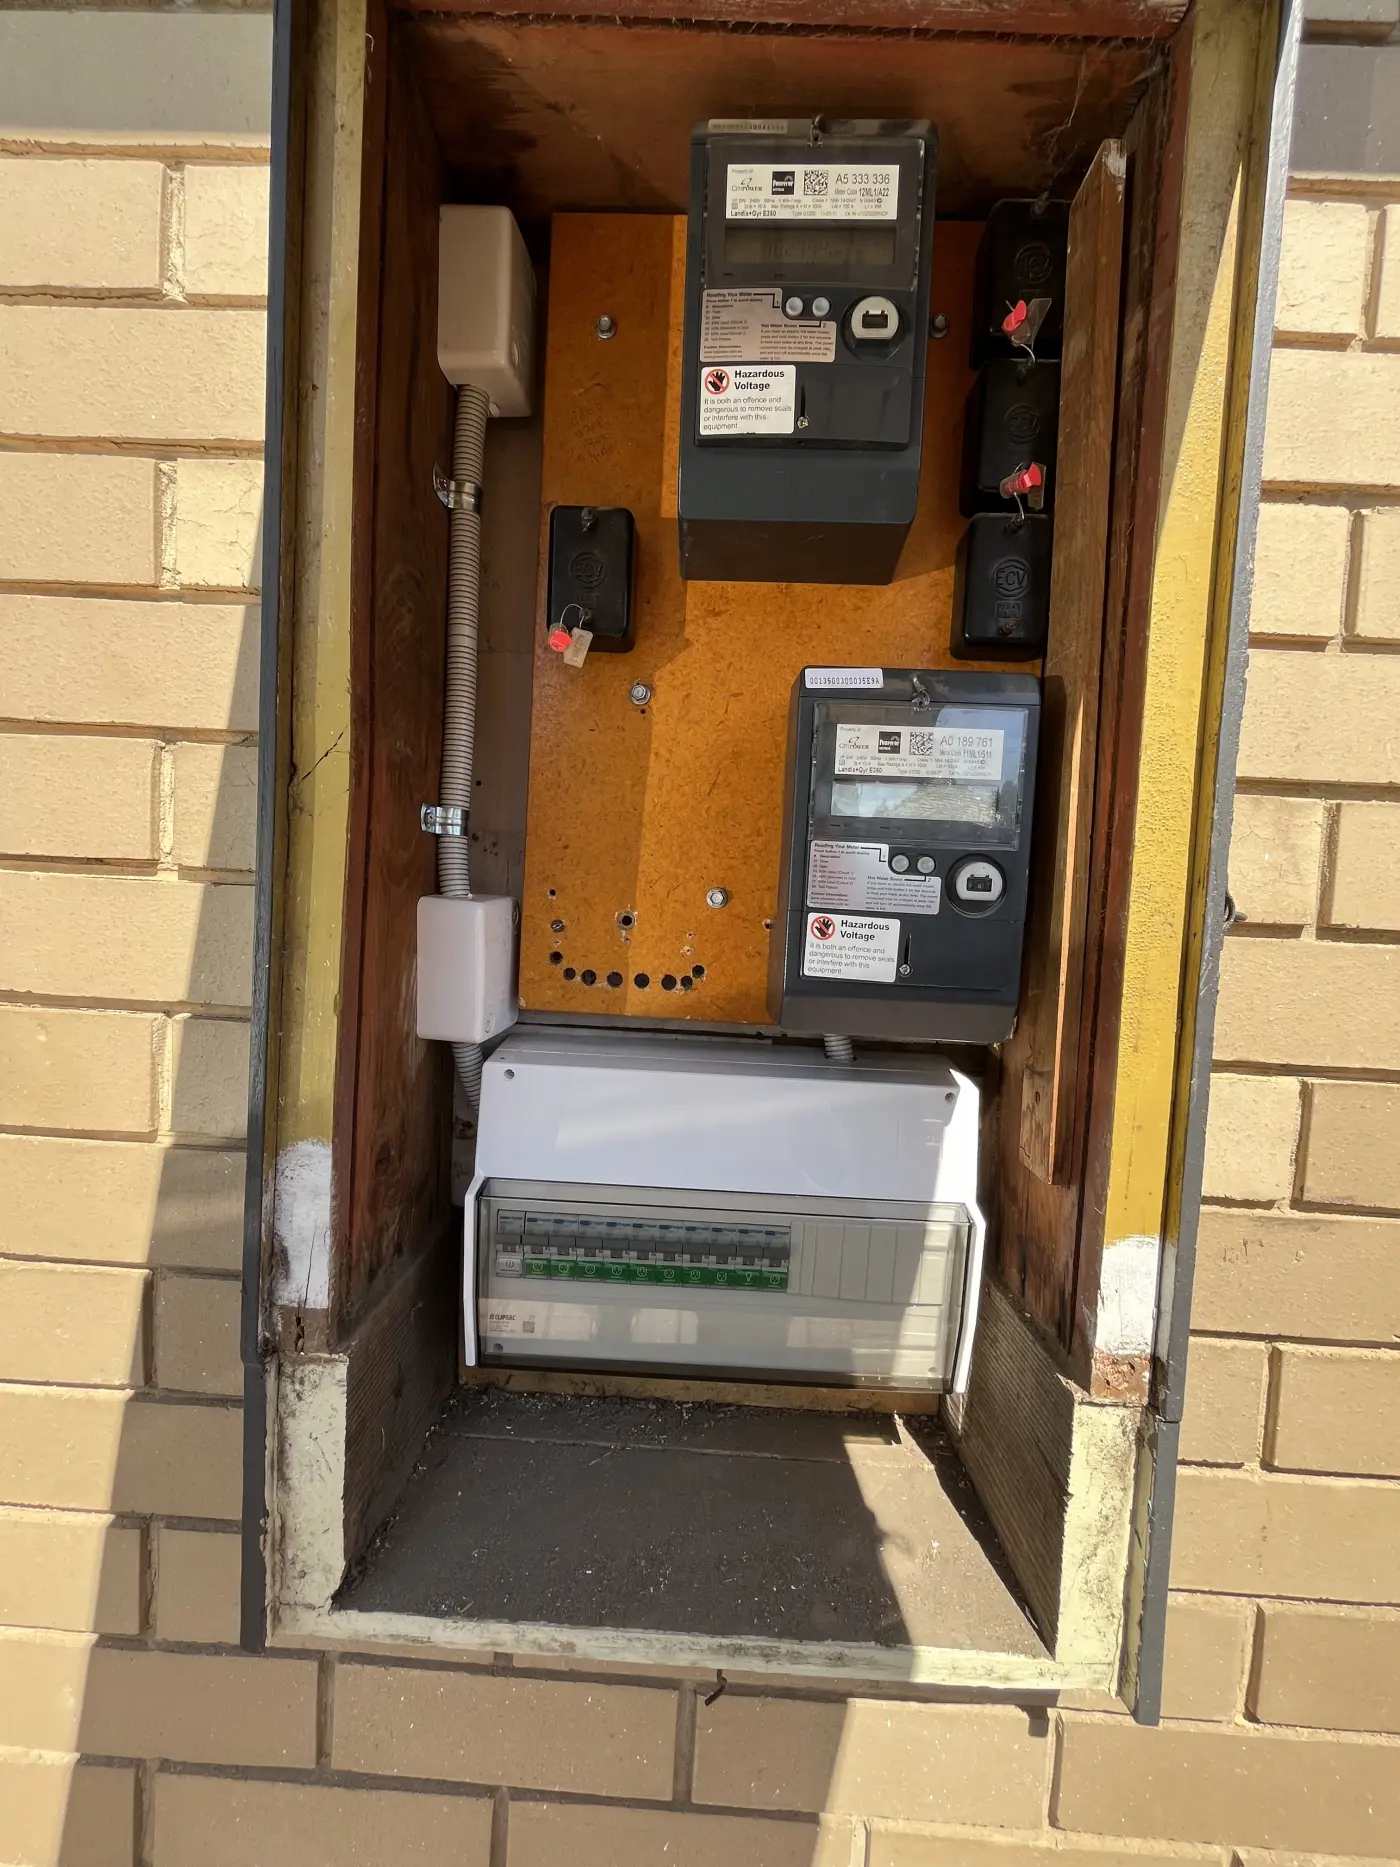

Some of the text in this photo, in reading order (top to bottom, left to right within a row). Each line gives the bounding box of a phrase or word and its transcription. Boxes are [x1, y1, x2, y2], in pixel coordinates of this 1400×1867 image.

[836, 174, 890, 184] A5 333 336
[734, 370, 785, 378] Hazardous
[734, 382, 770, 391] Voltage
[996, 570, 1027, 585] ECV
[940, 736, 993, 747] A0 189 761
[841, 920, 890, 930] Hazardous
[840, 931, 875, 941] Voltage
